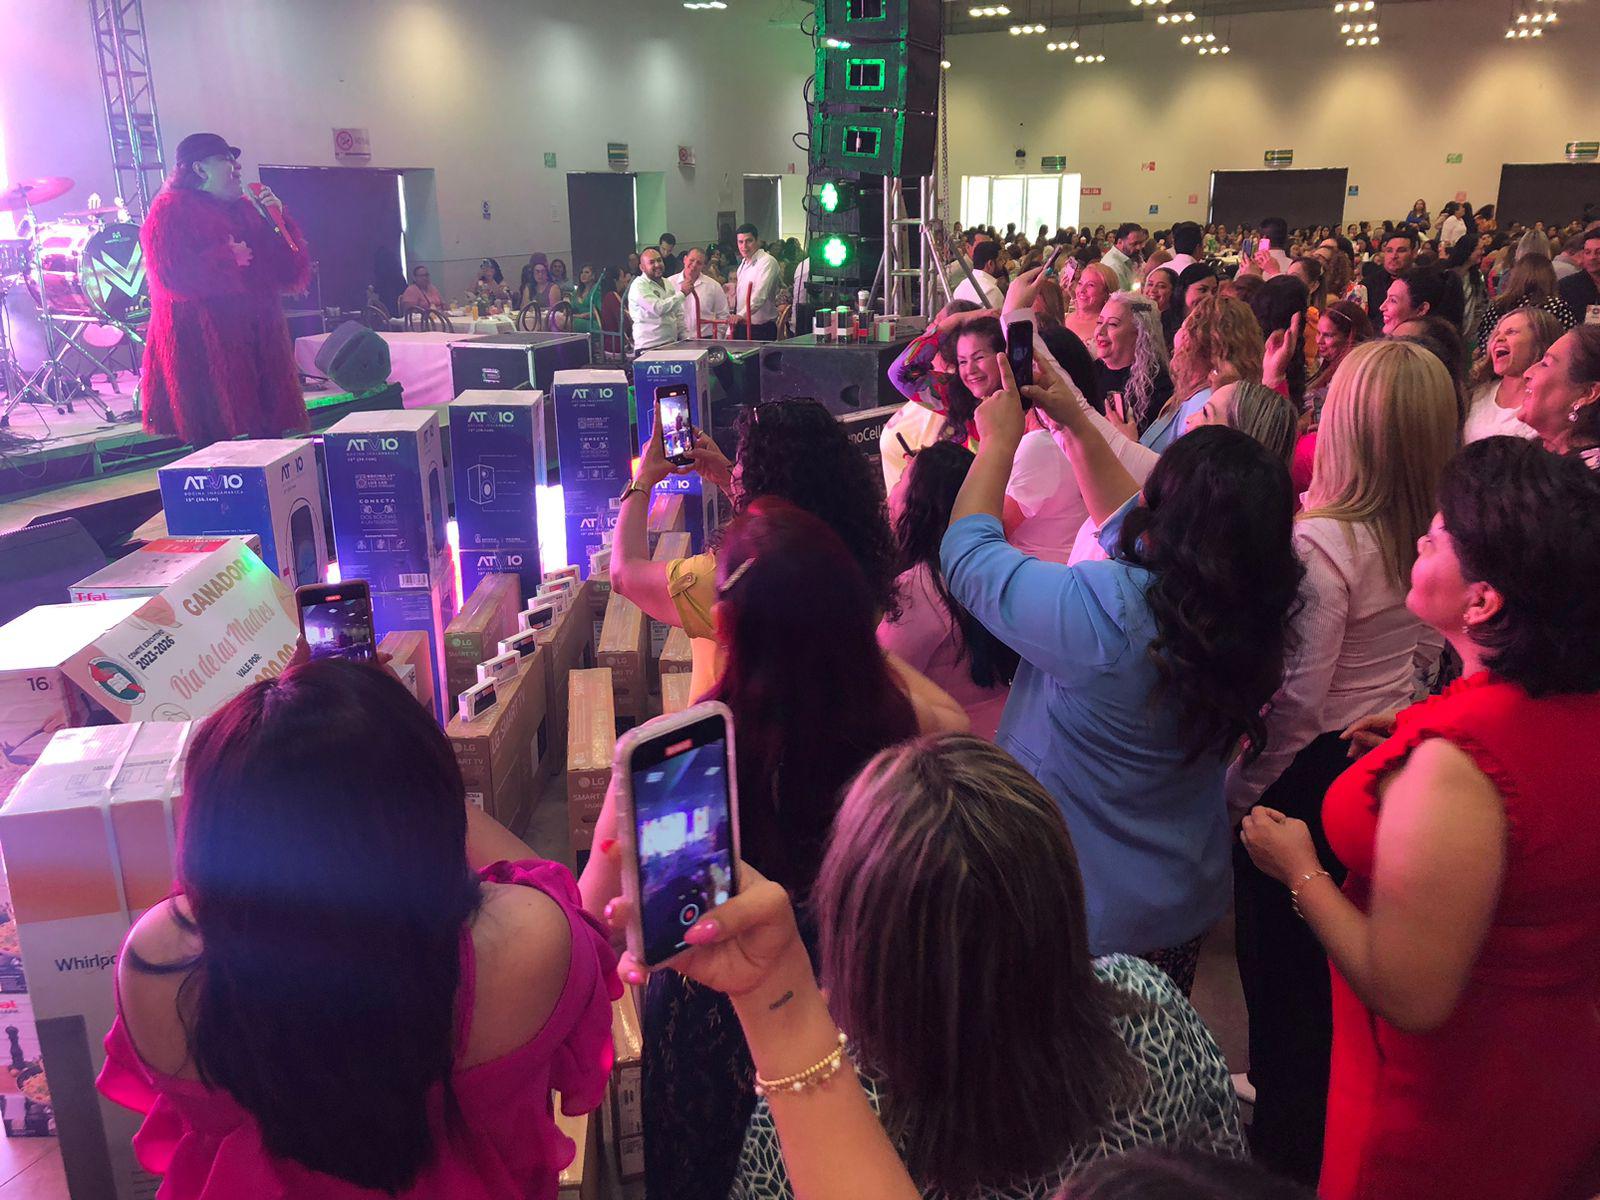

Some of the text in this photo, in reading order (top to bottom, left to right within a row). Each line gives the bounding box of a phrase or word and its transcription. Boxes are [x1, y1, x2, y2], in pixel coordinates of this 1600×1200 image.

[646, 364, 682, 374] ATIO
[571, 388, 613, 399] ATIO
[848, 425, 881, 444] noCell
[346, 438, 399, 451] ATVIO
[281, 456, 304, 482] ATIO
[184, 474, 243, 490] ATVIO
[655, 480, 690, 489] ATIO
[580, 518, 618, 528] ATIO
[227, 601, 275, 646] Madres
[27, 676, 50, 691] 16
[463, 744, 476, 752] LG
[592, 777, 605, 786] LG
